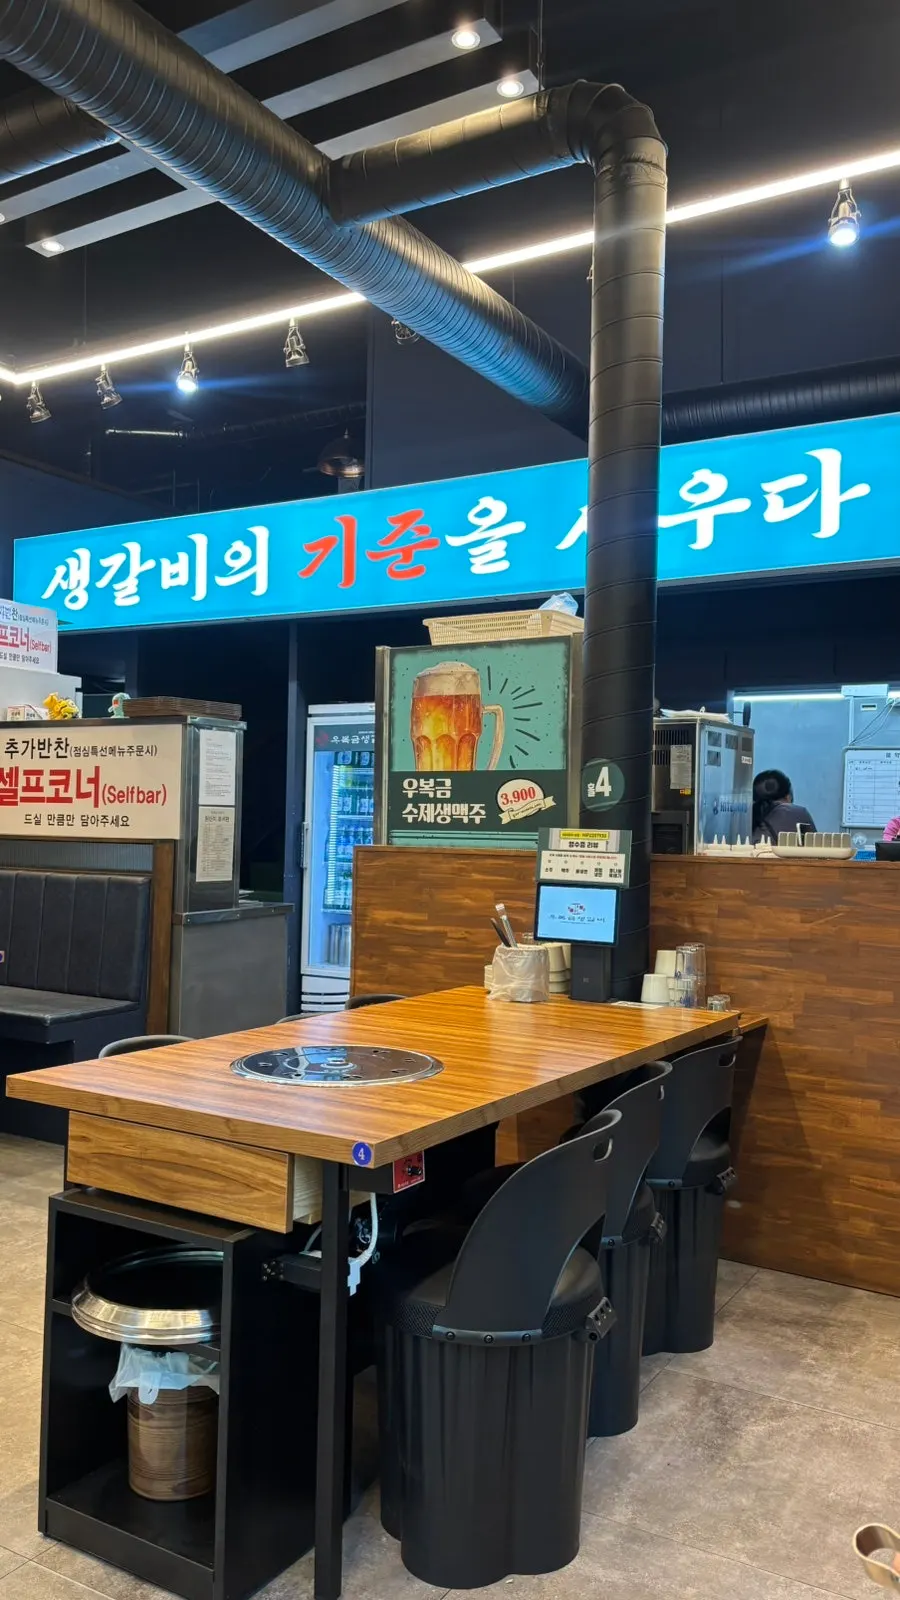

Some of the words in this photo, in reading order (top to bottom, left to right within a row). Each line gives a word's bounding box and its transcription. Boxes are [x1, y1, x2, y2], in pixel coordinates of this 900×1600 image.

[41, 525, 270, 611] 생갈비의
[555, 447, 871, 551] 우다
[402, 778, 452, 799] 우복금
[500, 786, 536, 806] 3,900
[24, 814, 42, 826] 드실
[47, 814, 75, 827] 만큼만
[80, 814, 130, 828] 담아주세요
[402, 803, 486, 825] 수제생맥주
[358, 1147, 366, 1161] 4
